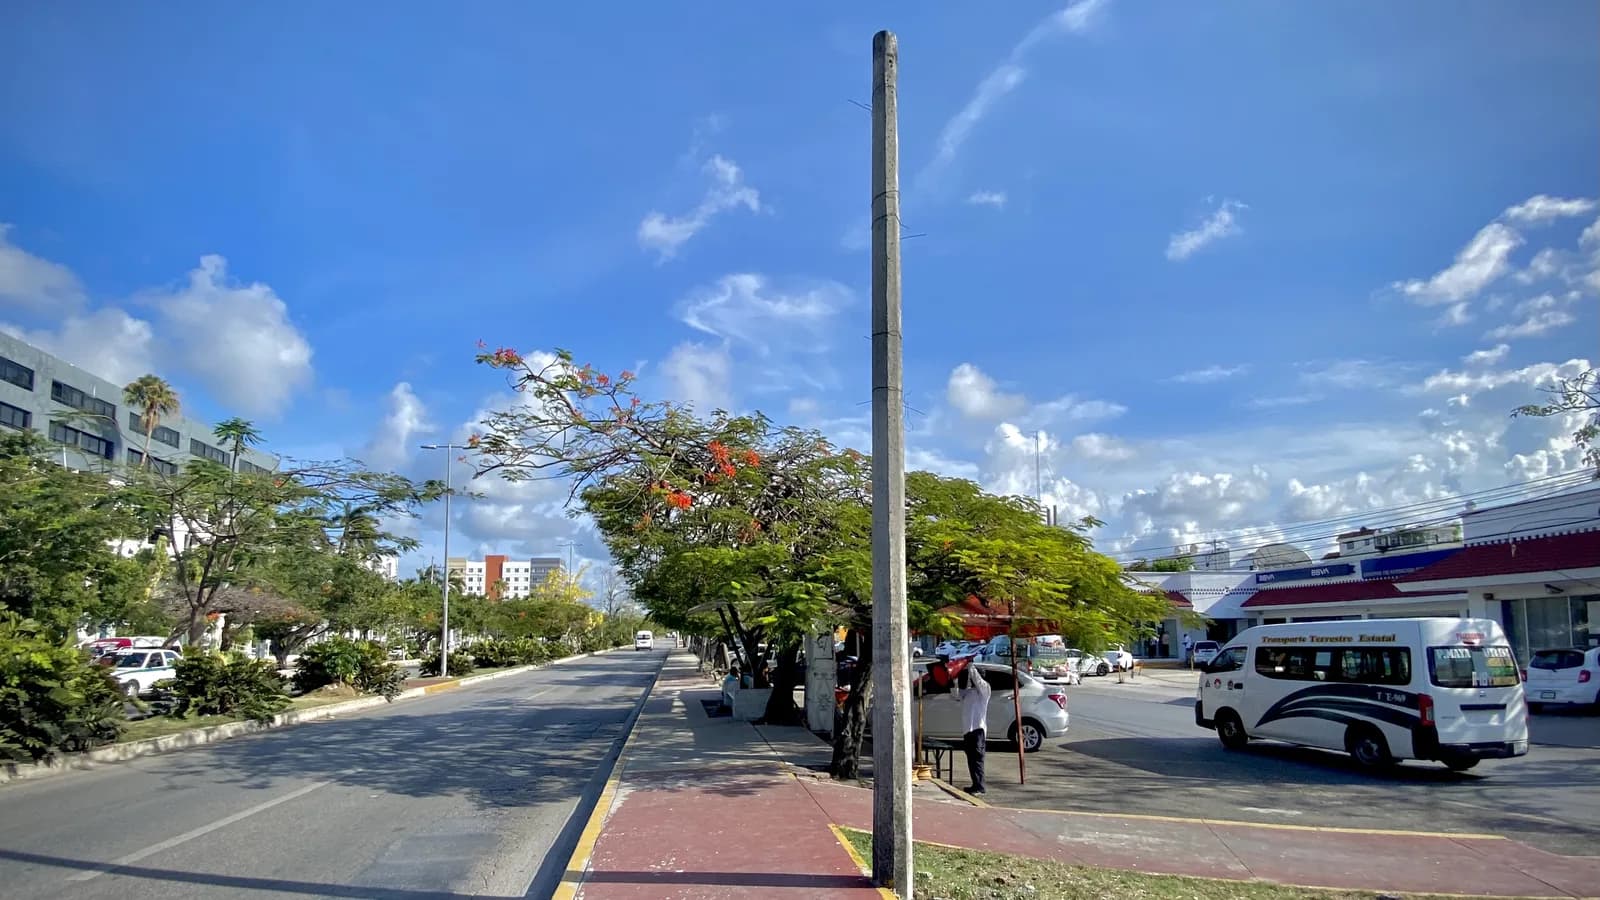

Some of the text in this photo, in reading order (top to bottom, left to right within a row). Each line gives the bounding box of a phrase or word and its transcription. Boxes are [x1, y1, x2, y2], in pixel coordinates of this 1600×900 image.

[1311, 568, 1329, 576] BBVA
[1258, 574, 1275, 582] BBVA
[1262, 633, 1396, 644] Transporte Terrestre Estatal
